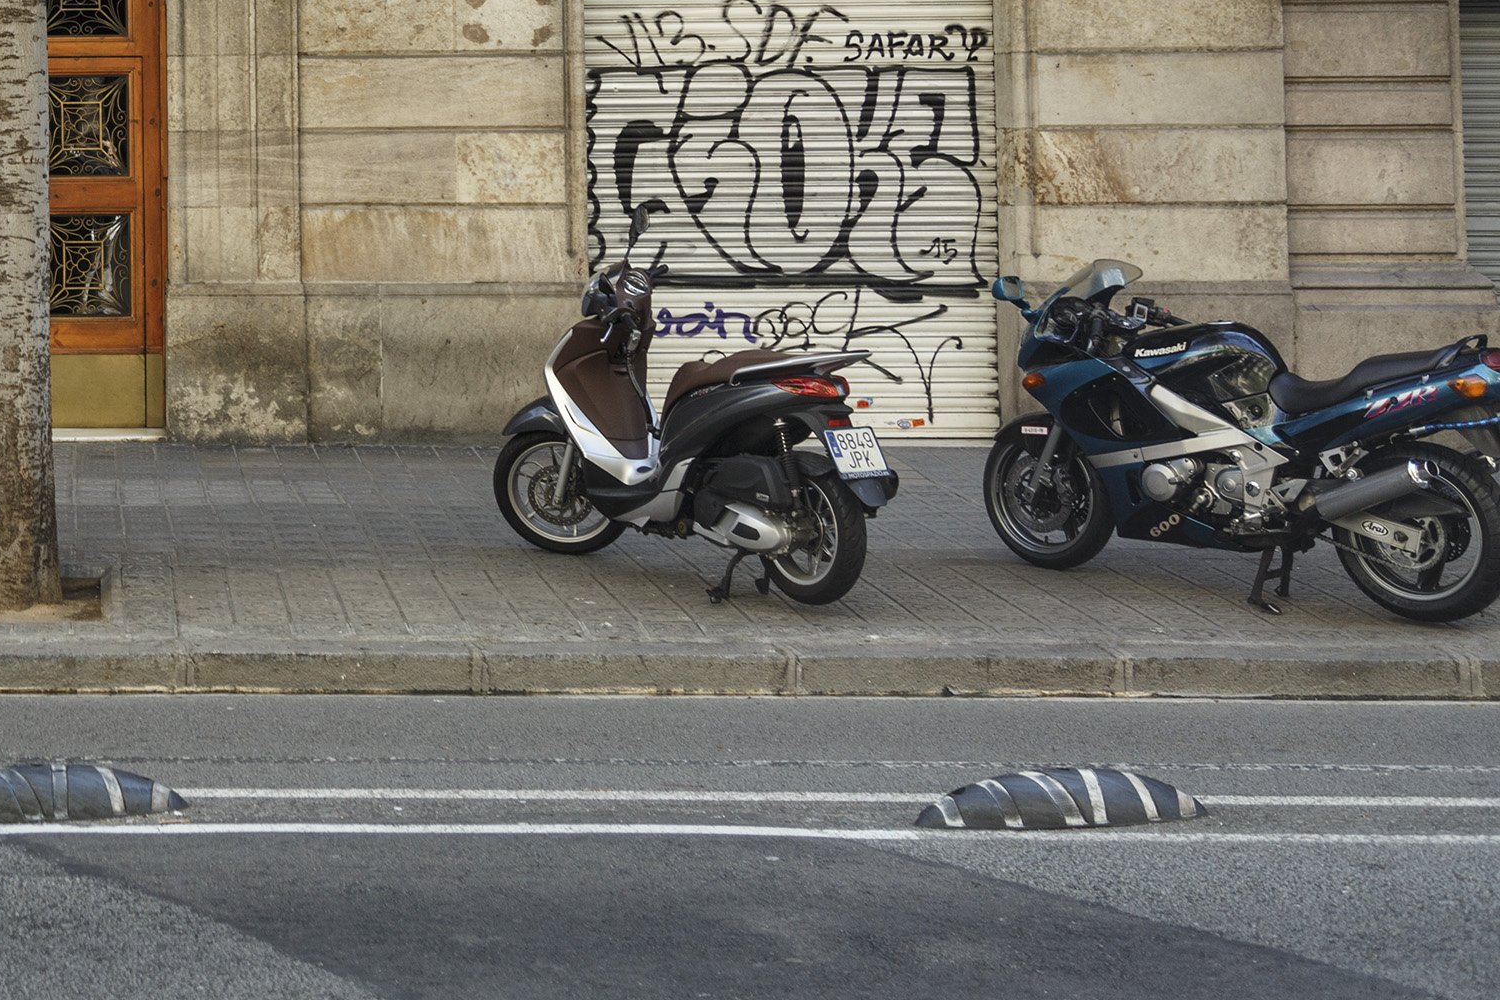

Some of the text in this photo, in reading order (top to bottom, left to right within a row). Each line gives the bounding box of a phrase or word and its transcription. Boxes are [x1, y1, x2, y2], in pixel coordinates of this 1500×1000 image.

[1134, 341, 1187, 357] Kawasaki
[836, 431, 874, 450] 8849
[849, 450, 875, 469] JPK
[1149, 513, 1181, 538] 600
[1365, 521, 1387, 535] Arai
